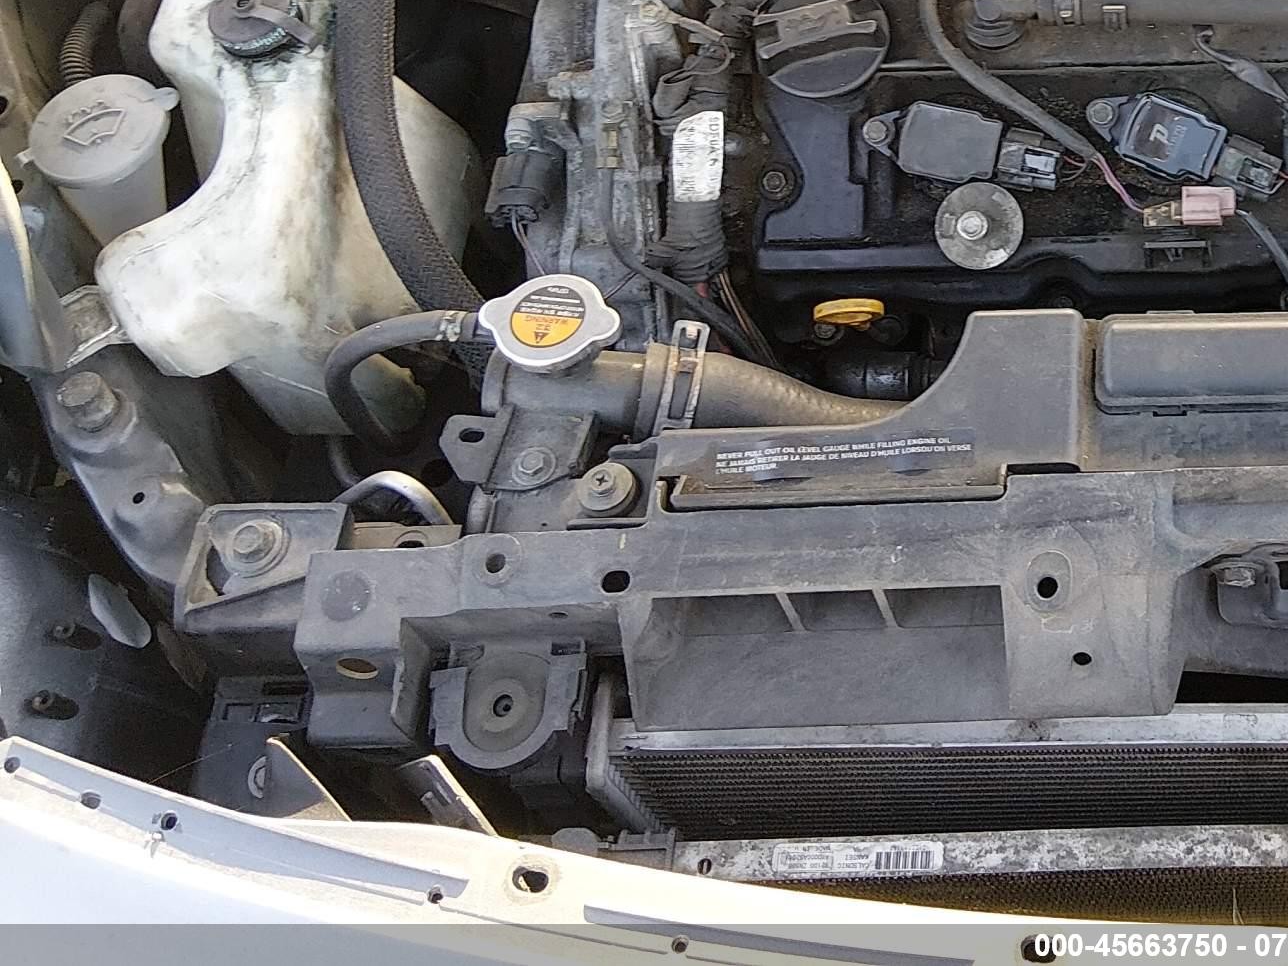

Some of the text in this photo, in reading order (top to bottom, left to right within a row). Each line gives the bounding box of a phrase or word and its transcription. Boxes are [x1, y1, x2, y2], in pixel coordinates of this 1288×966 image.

[764, 447, 781, 455] OUT
[822, 444, 850, 453] GAUGE
[828, 452, 840, 460] DE
